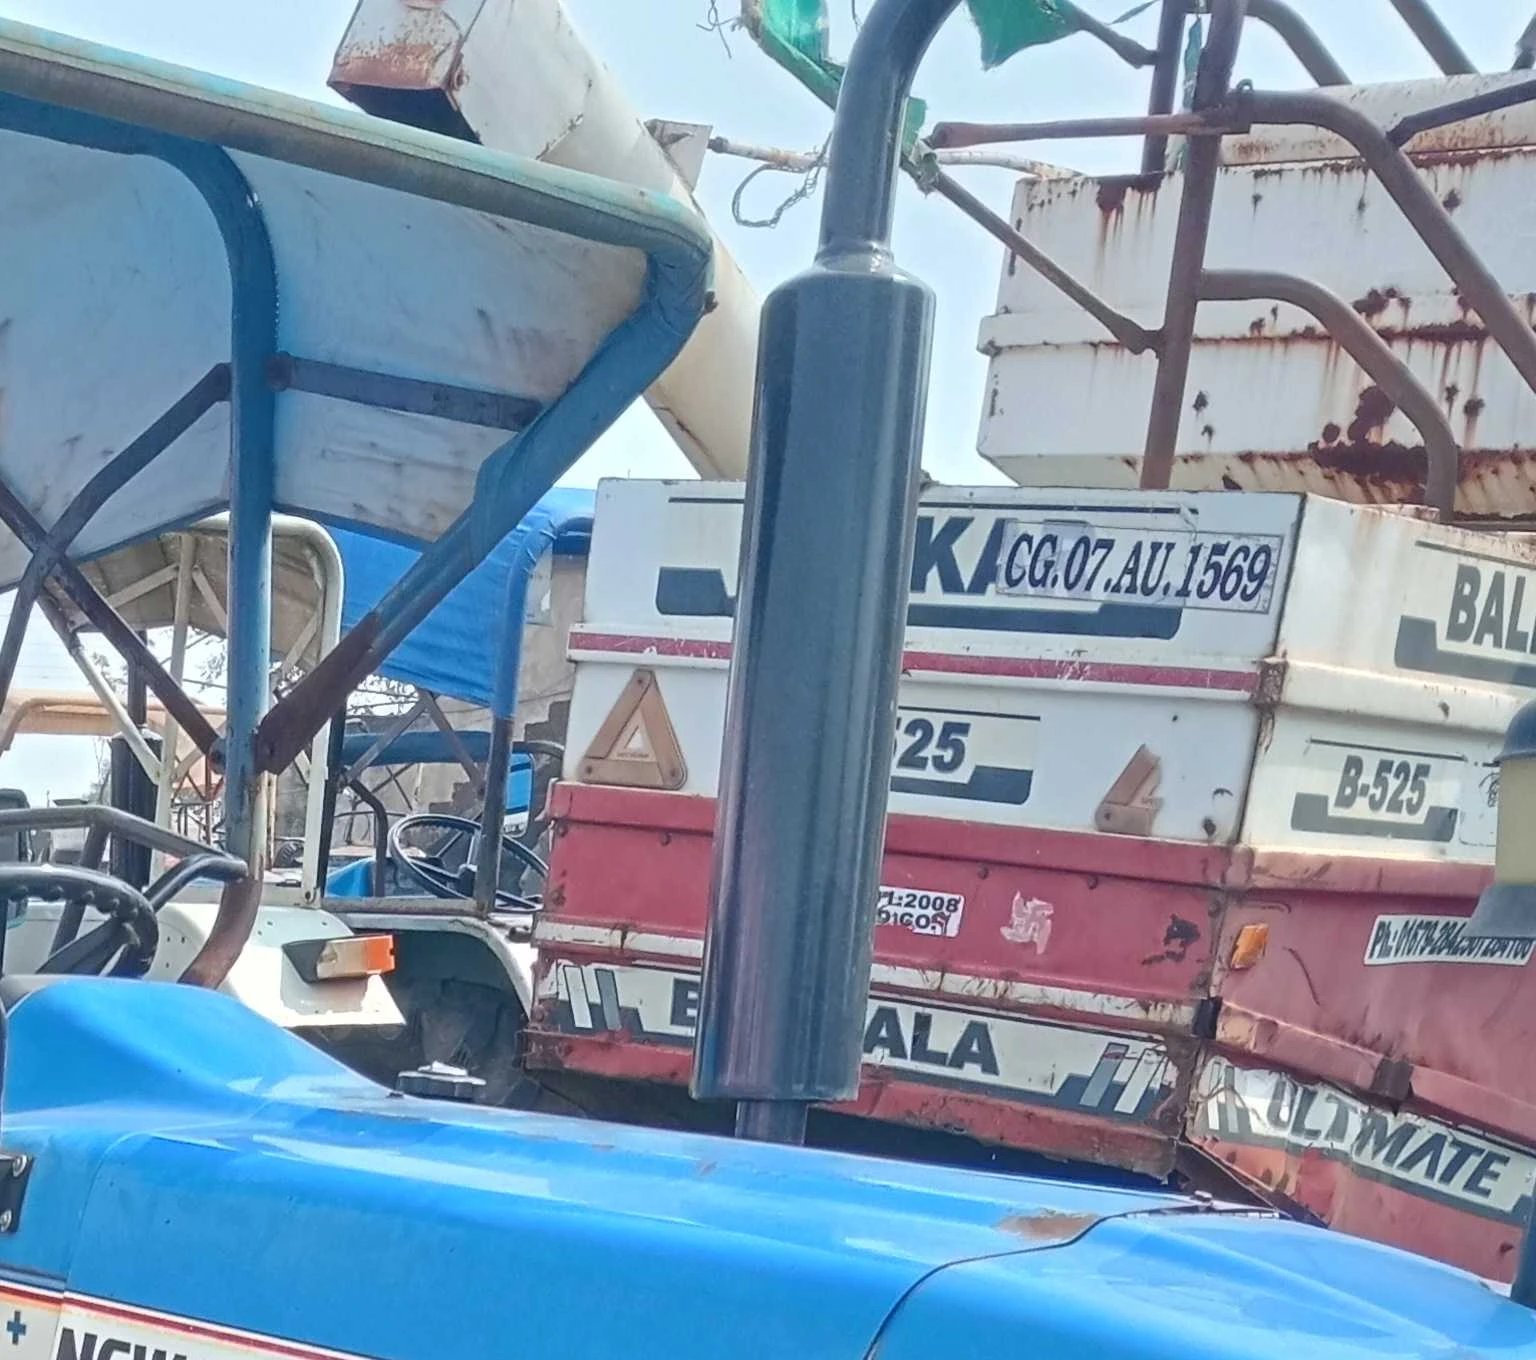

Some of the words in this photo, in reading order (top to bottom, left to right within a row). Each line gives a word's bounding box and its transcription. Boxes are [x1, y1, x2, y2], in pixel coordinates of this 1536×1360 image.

[1004, 533, 1272, 602] CG.07.AU.1569
[1445, 563, 1536, 655] BAL
[893, 716, 971, 774] 25
[1333, 754, 1432, 816] B-525
